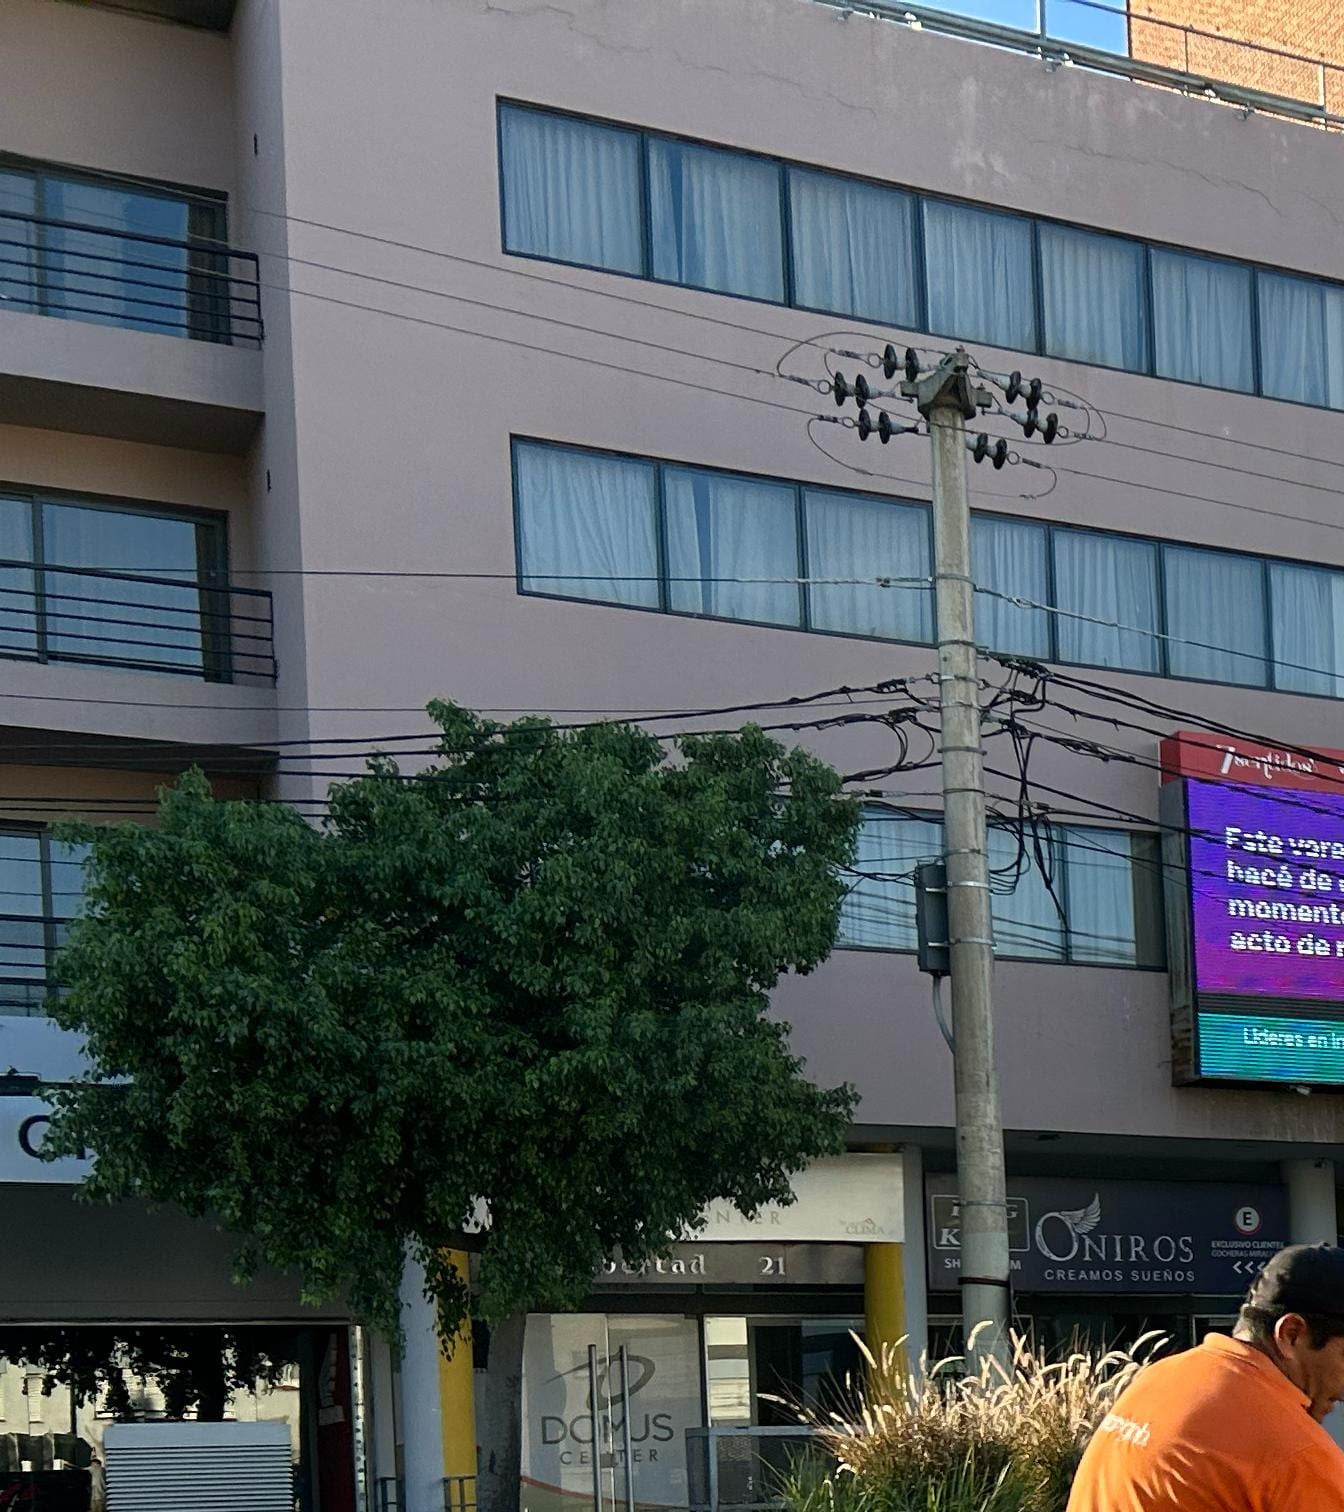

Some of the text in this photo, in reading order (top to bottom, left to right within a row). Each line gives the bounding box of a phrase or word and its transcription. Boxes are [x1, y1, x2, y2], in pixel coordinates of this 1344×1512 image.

[1226, 859, 1293, 888] hacé
[1300, 868, 1332, 891] de
[1230, 930, 1291, 953] acto
[1297, 933, 1331, 956] de
[1307, 1035, 1328, 1048] en
[1242, 1211, 1253, 1226] E
[1035, 1211, 1194, 1263] ONIROS
[1211, 1240, 1251, 1249] EXCLUSIVO
[758, 1256, 787, 1276] 21
[1044, 1268, 1195, 1282] CREAMOS SUEÑOS
[541, 1414, 674, 1444] DOMUS
[560, 1449, 659, 1465] CETER
